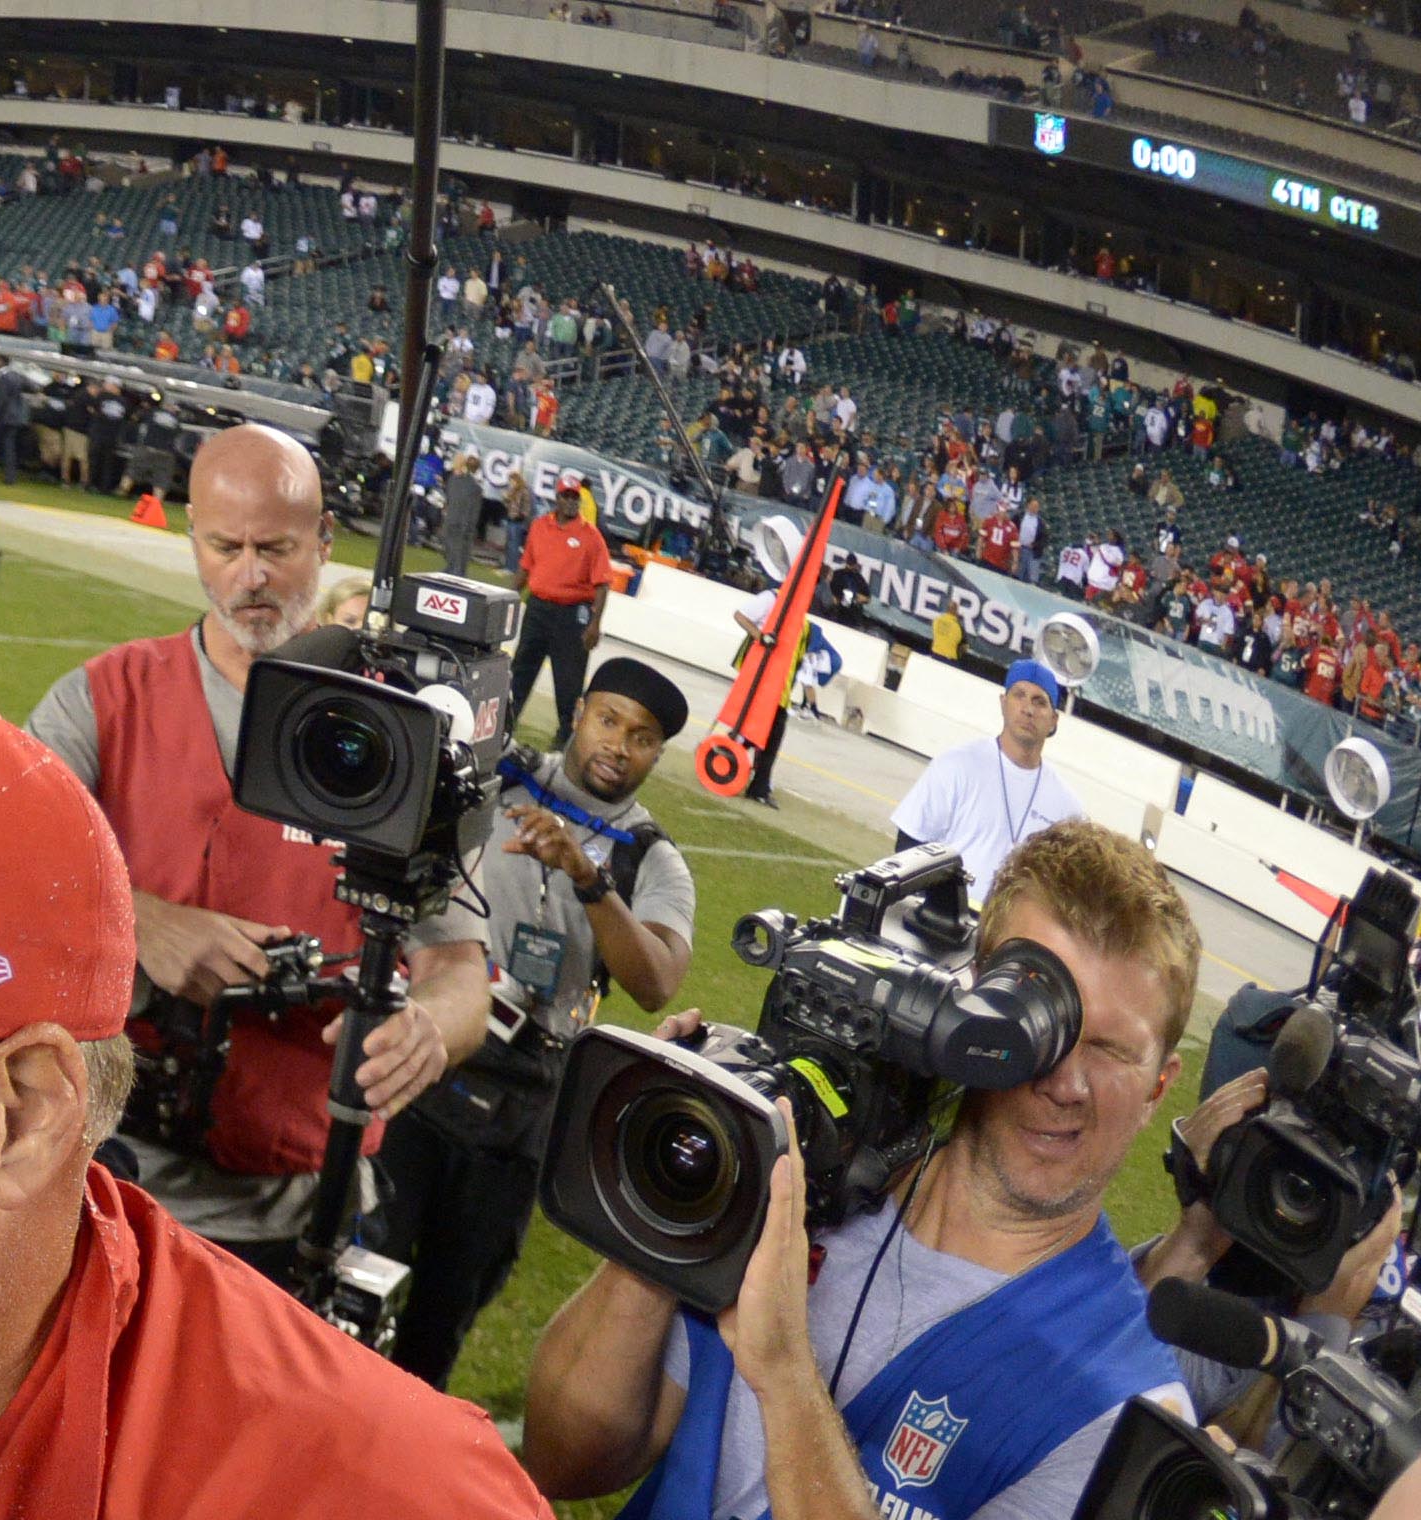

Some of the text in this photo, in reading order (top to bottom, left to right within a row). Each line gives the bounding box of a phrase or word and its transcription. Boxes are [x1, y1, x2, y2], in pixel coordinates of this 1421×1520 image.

[1132, 138, 1196, 180] 0:00
[1271, 178, 1380, 231] 4TH QTR
[423, 593, 461, 616] AVS
[889, 1424, 940, 1477] NFL
